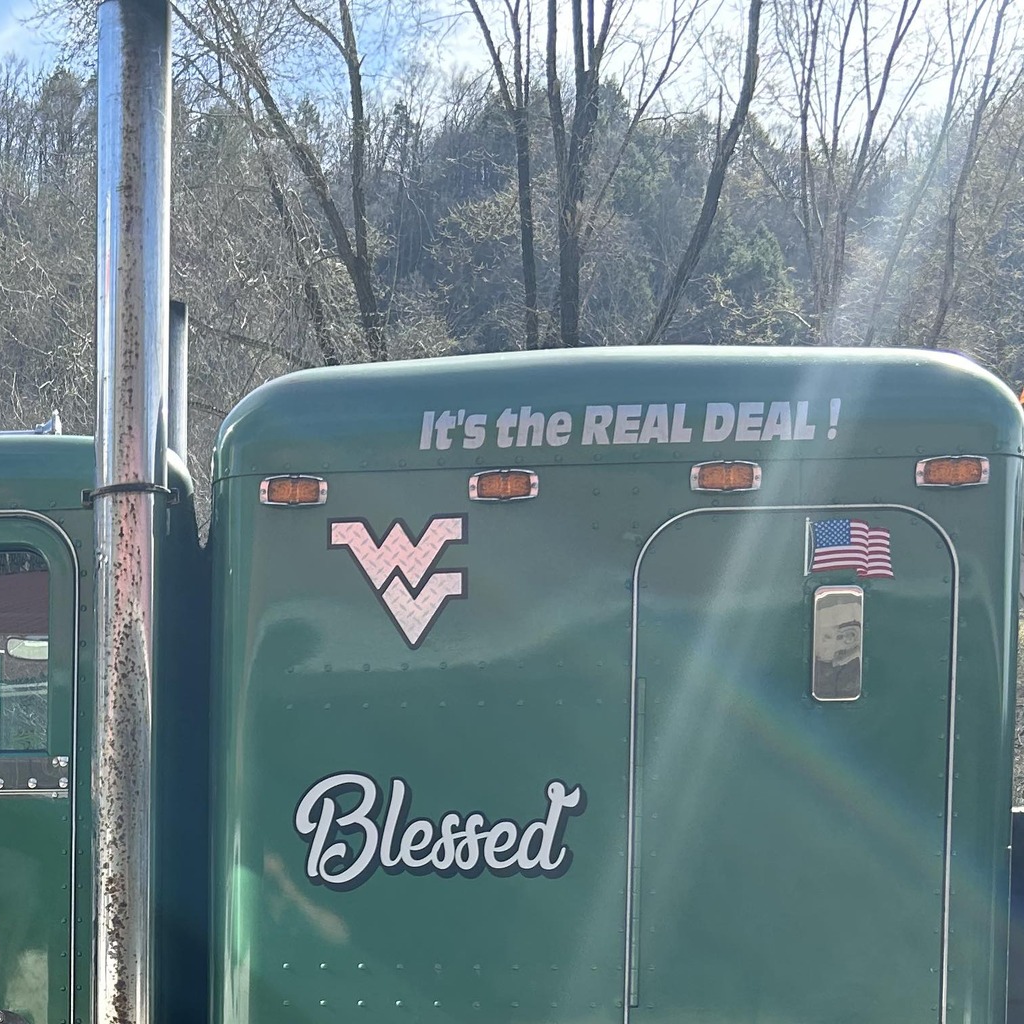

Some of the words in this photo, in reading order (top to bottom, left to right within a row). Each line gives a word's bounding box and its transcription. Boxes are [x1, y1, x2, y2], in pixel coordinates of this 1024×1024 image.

[419, 409, 487, 450] It's
[496, 405, 572, 448] the
[581, 403, 693, 445] REAL
[702, 401, 816, 442] DEAL
[295, 773, 580, 884] Blessed
